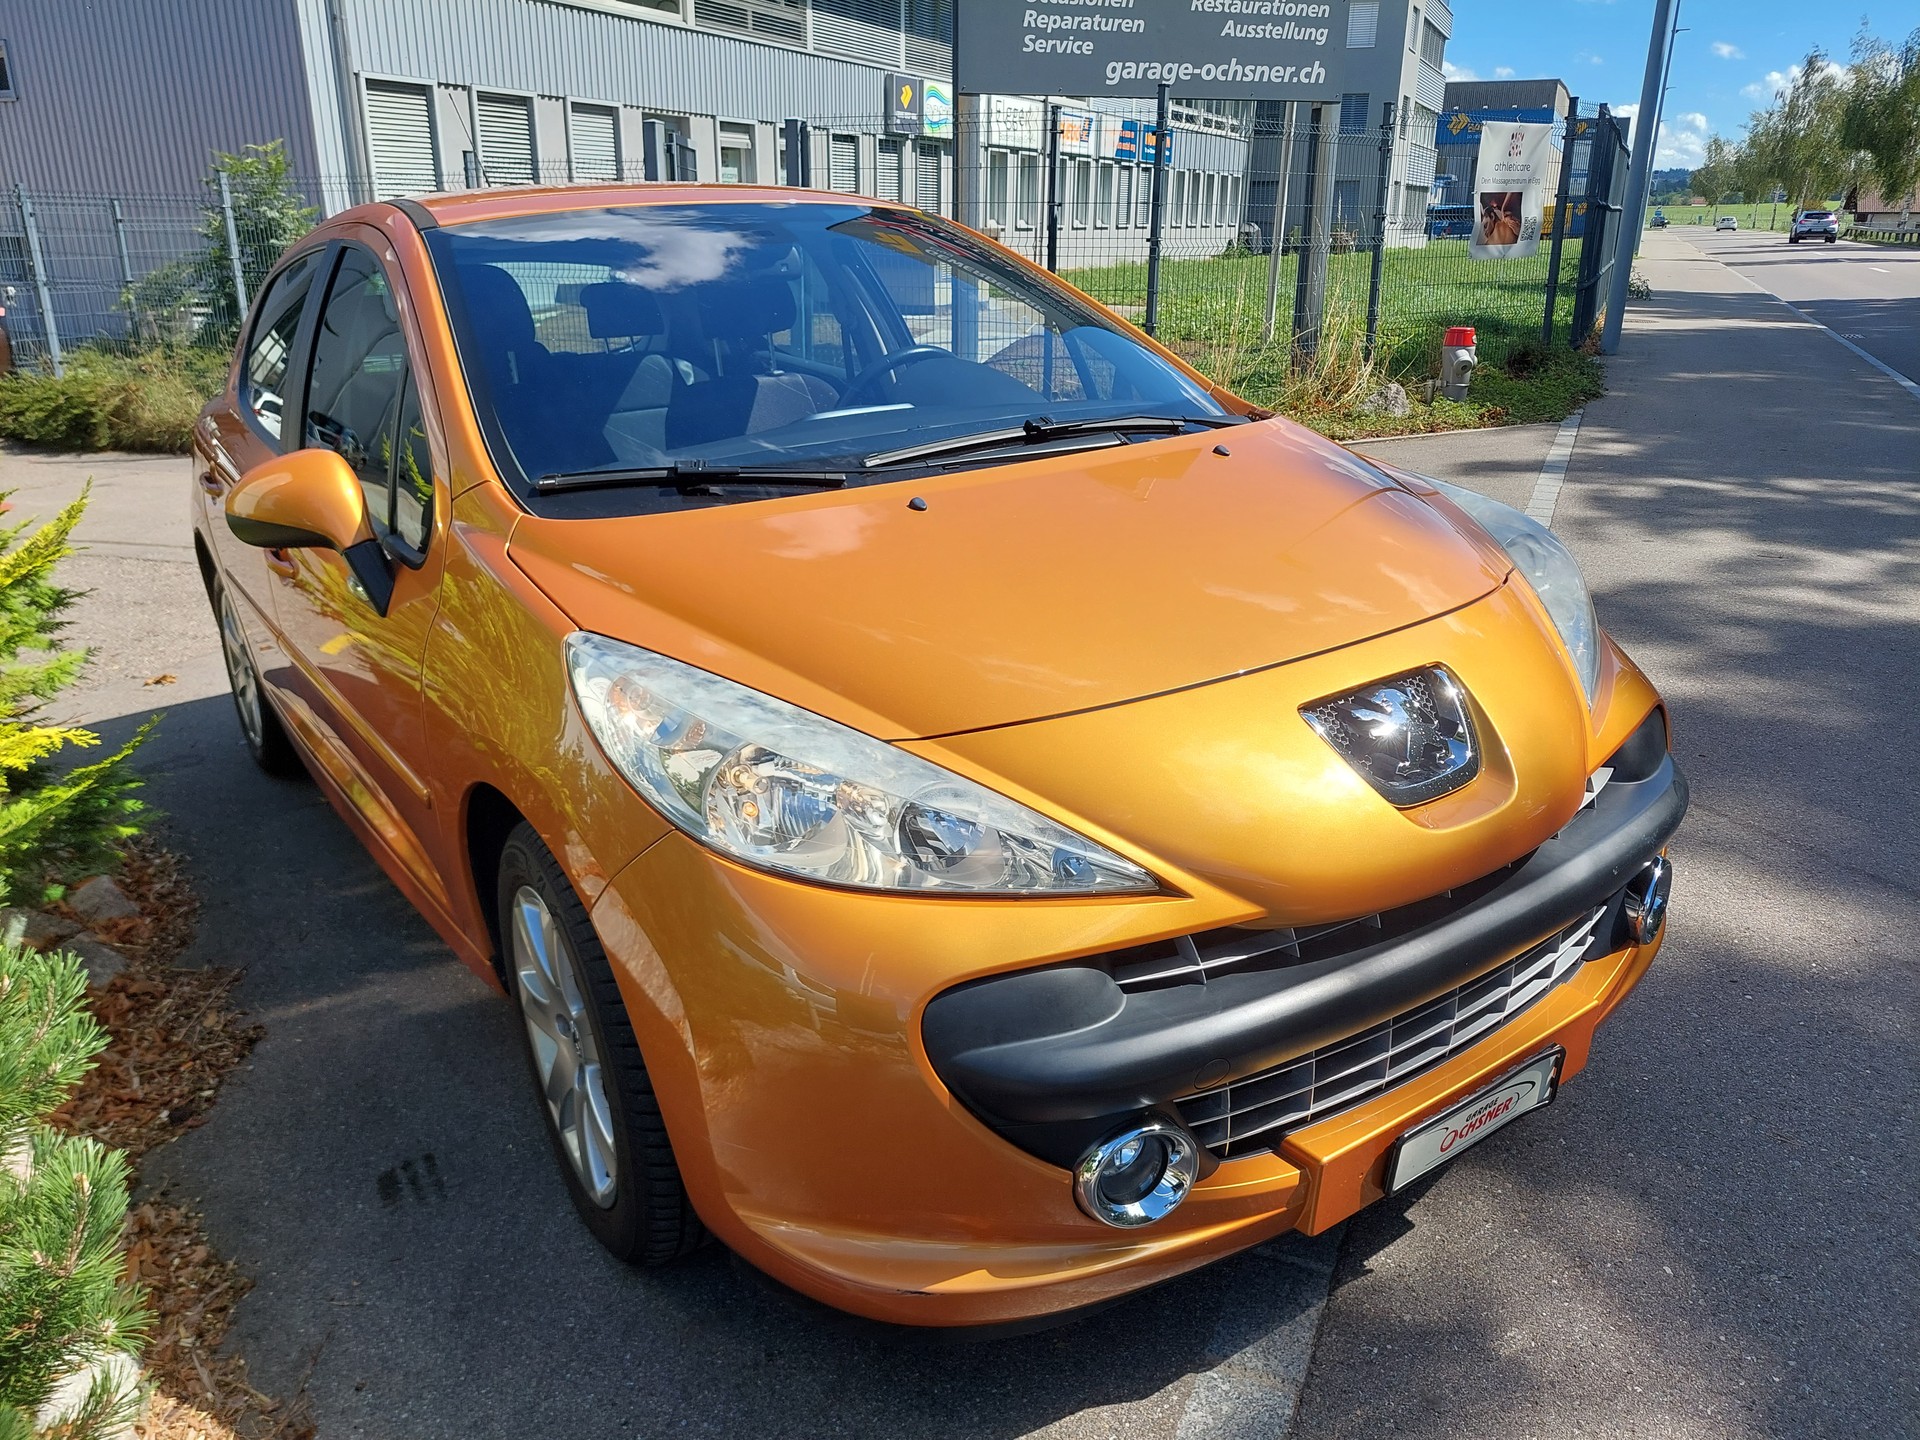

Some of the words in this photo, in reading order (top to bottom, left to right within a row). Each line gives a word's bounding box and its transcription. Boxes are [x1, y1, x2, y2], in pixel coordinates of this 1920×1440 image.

[1022, 9, 1145, 33] Reparaturen
[1190, 0, 1330, 18] Restaurationen
[1022, 34, 1094, 55] Service
[1220, 19, 1329, 46] Ausstellung
[1105, 57, 1326, 85] garage-ochsner.ch
[1494, 161, 1531, 172] athleticare
[1465, 1096, 1500, 1123] GARAGE
[1440, 1096, 1514, 1153] OCHSNER
